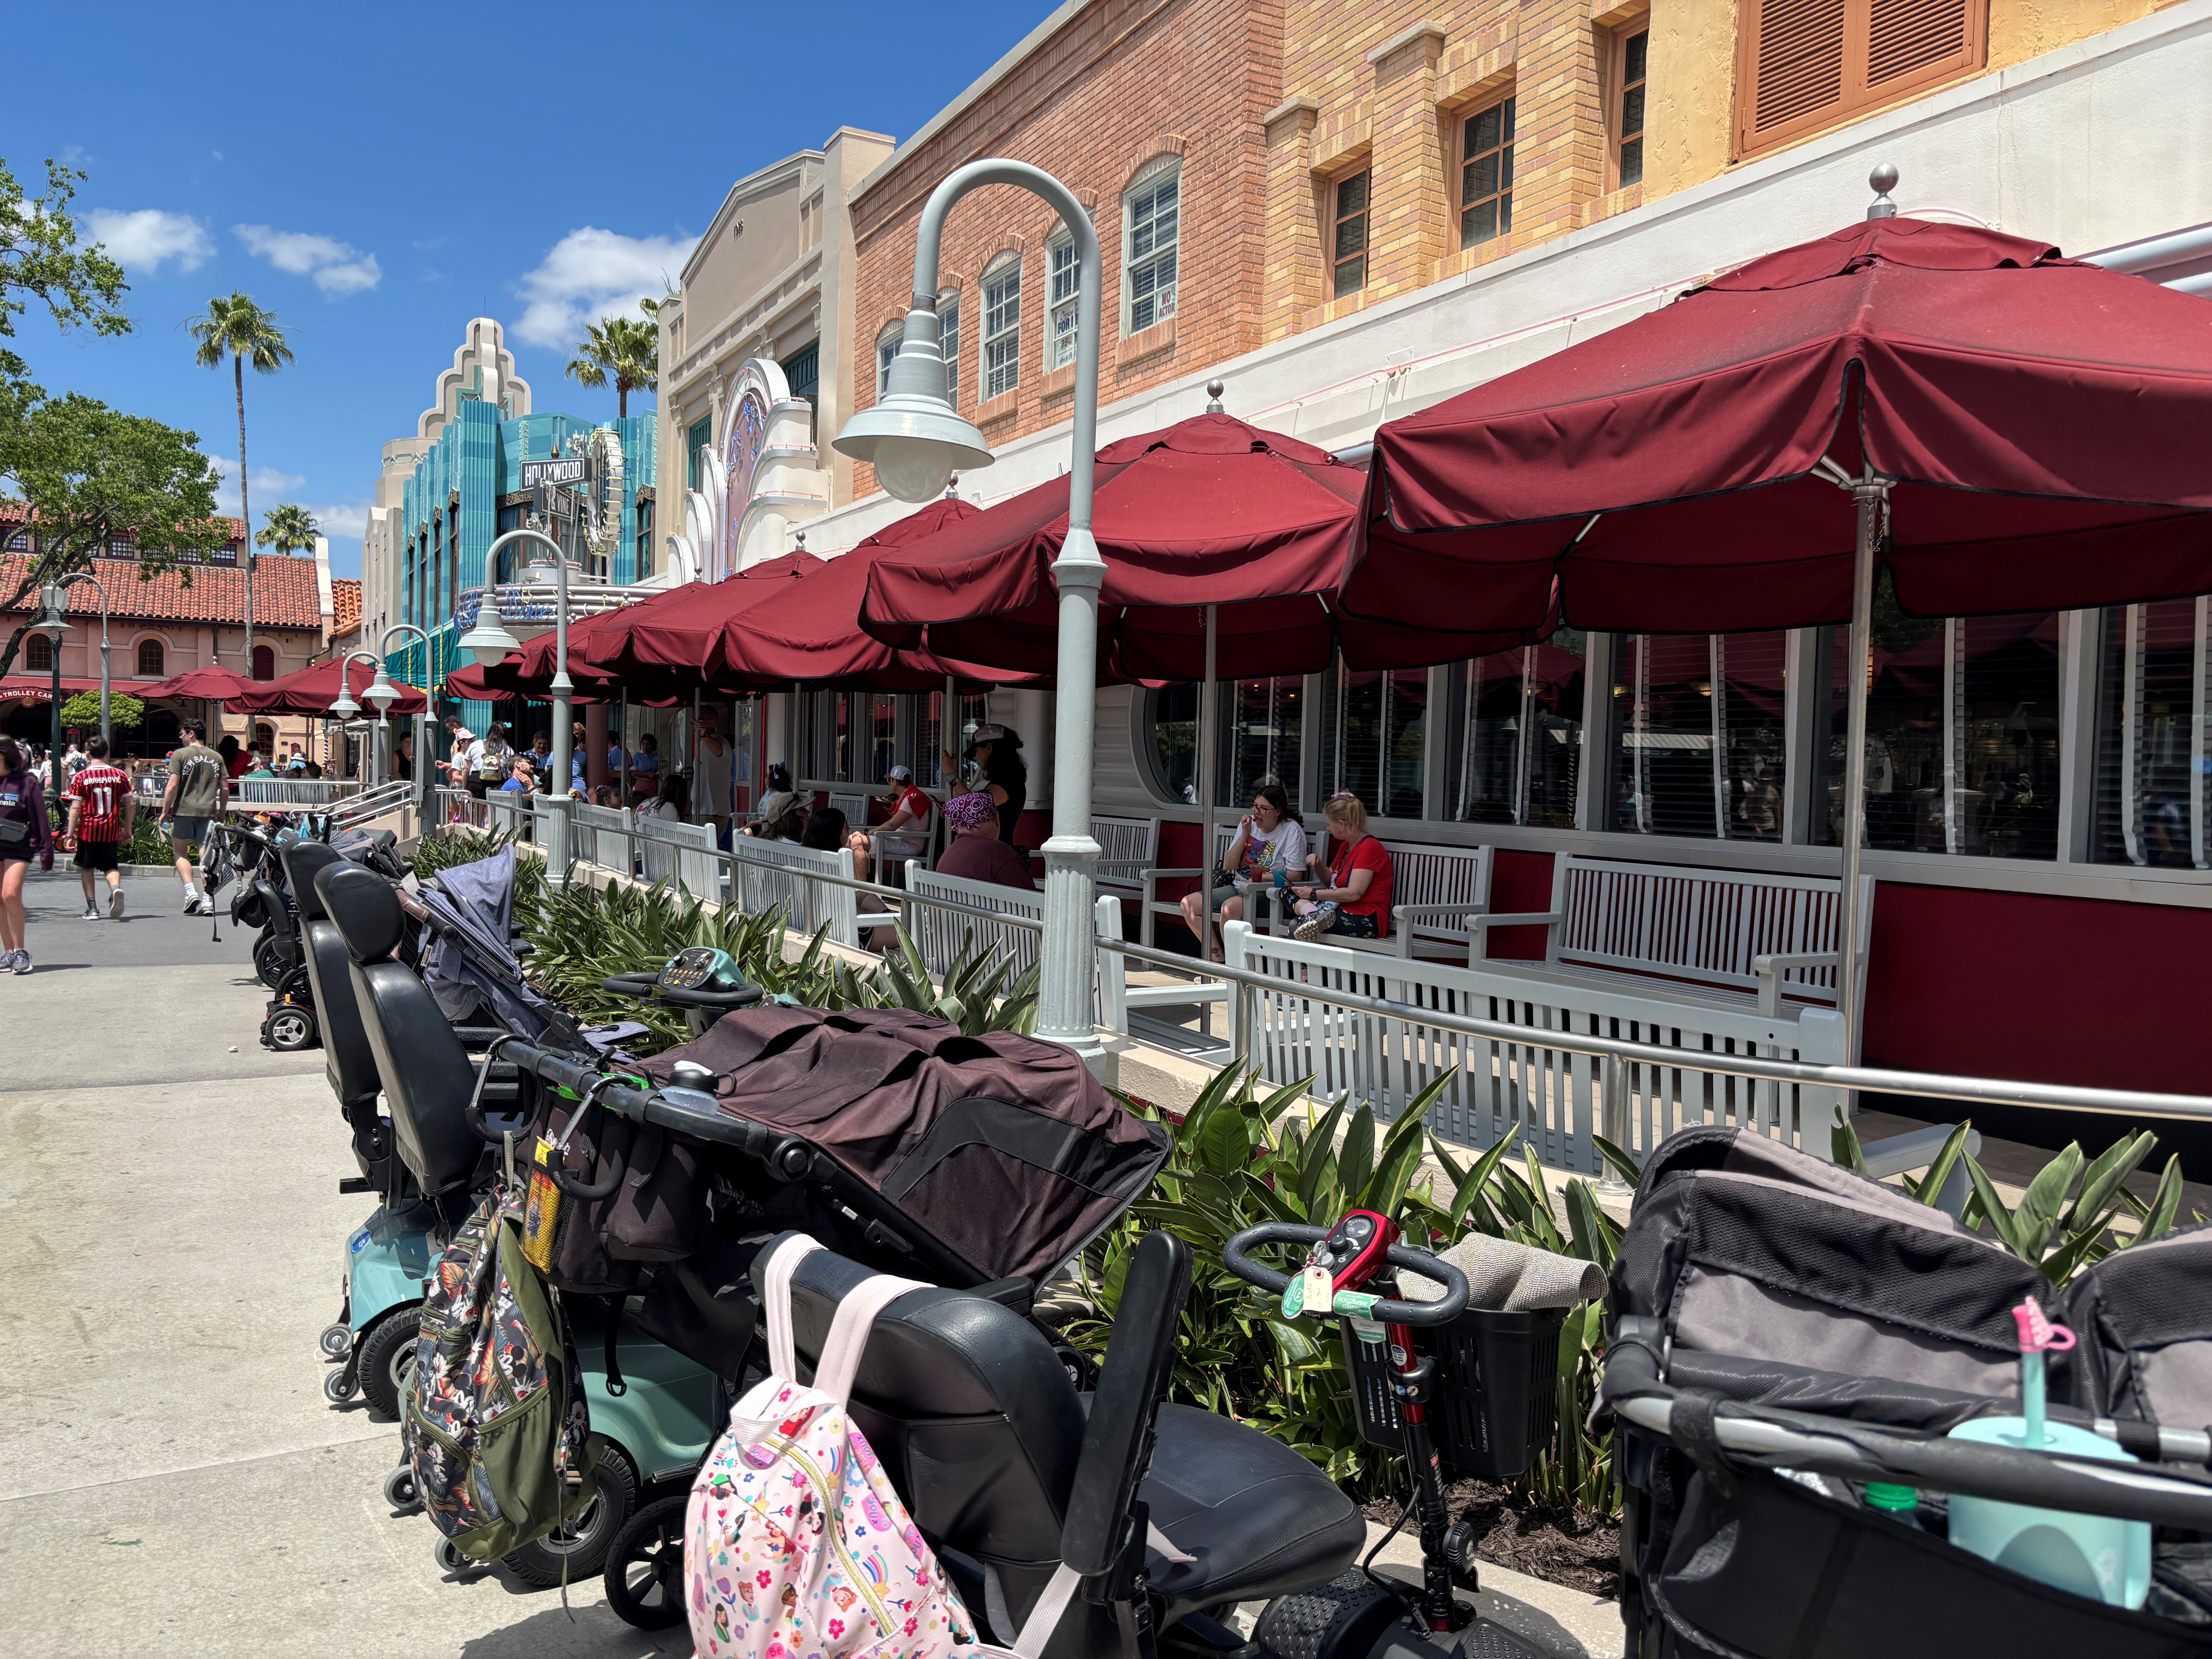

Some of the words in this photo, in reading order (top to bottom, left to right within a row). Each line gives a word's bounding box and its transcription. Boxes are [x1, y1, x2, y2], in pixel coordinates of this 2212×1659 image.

[1162, 291, 1171, 306] NO
[1058, 318, 1070, 335] FOR
[556, 494, 569, 515] VINE
[182, 759, 195, 775] NEW
[93, 787, 112, 815] 11
